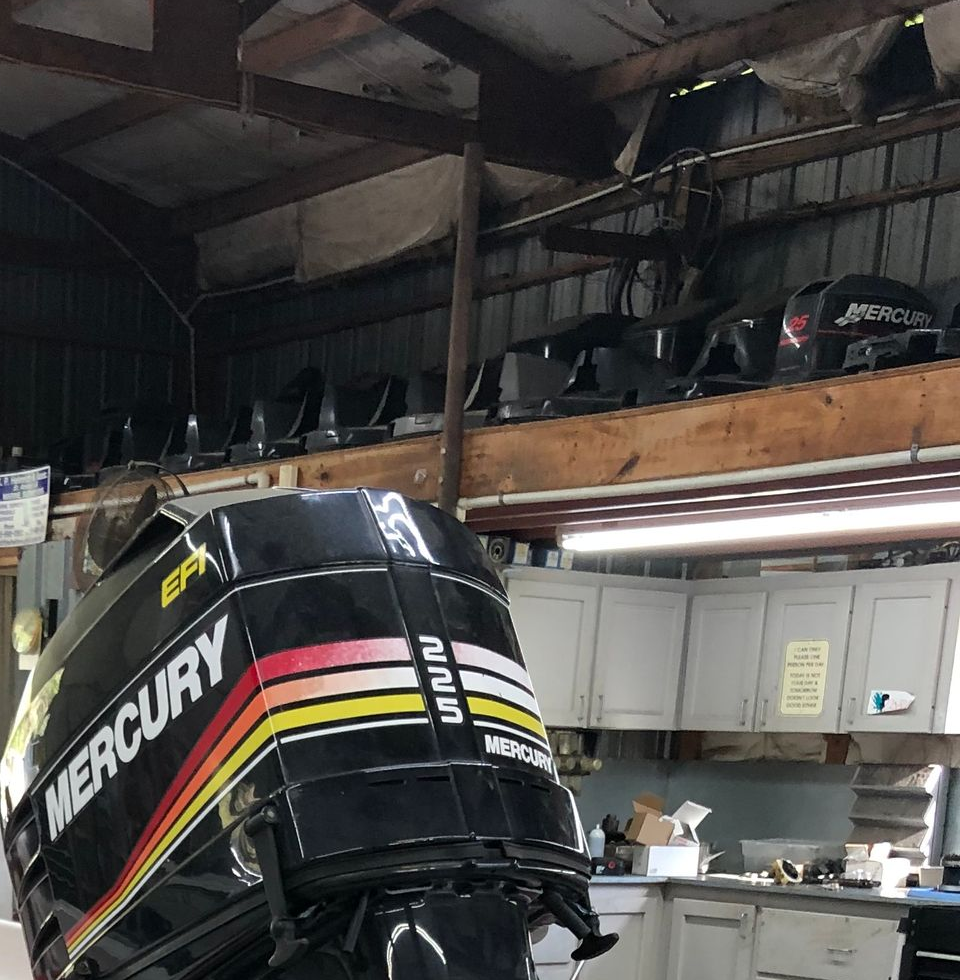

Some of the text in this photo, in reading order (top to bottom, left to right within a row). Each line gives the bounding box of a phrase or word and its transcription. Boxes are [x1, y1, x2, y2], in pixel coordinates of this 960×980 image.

[835, 302, 933, 329] MERCURY
[161, 543, 208, 609] EFI
[418, 635, 466, 724] 225
[44, 614, 229, 842] MERCURY
[484, 733, 555, 774] MERCURY
